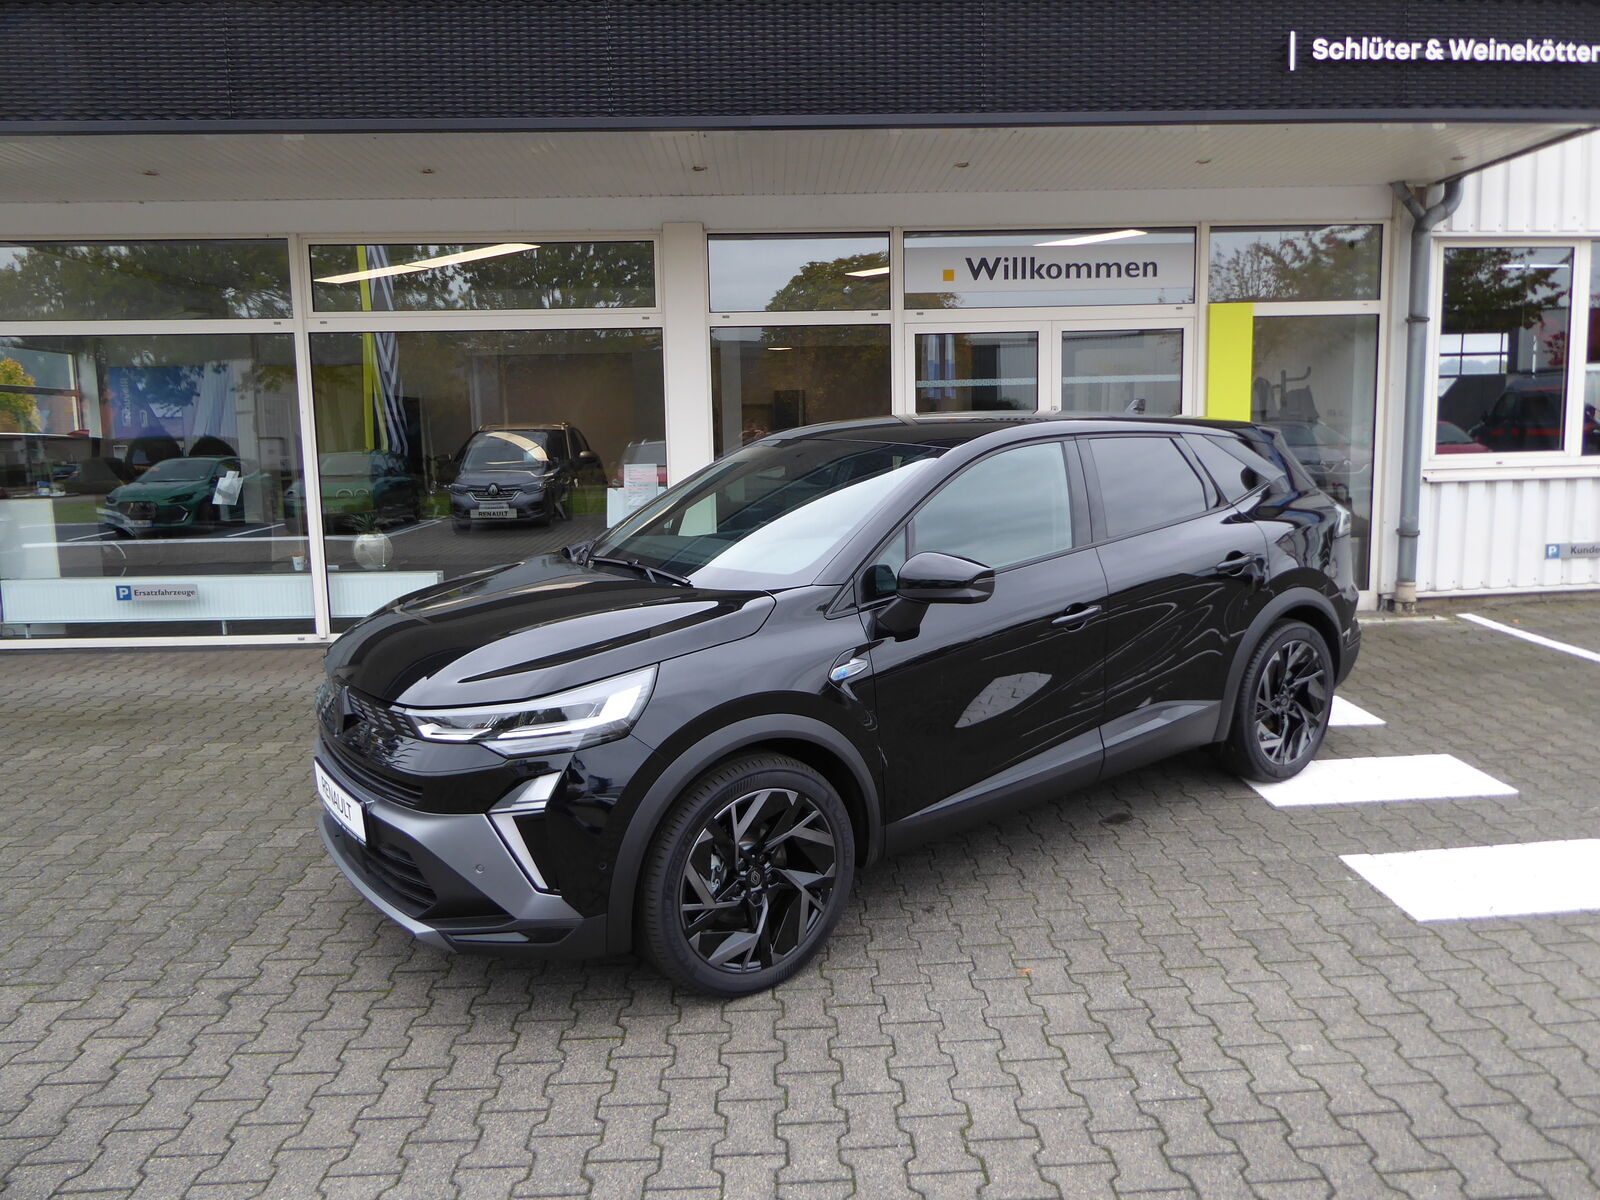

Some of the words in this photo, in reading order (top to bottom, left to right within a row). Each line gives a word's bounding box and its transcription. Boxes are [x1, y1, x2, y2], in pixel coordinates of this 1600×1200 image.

[1312, 36, 1422, 60] Schlüter
[1425, 38, 1444, 61] &
[1449, 38, 1600, 62] Weinekötter
[965, 256, 1158, 281] Willkommen
[134, 589, 195, 597] Ersatzfahrzeuge
[321, 775, 351, 821] RENAULT
